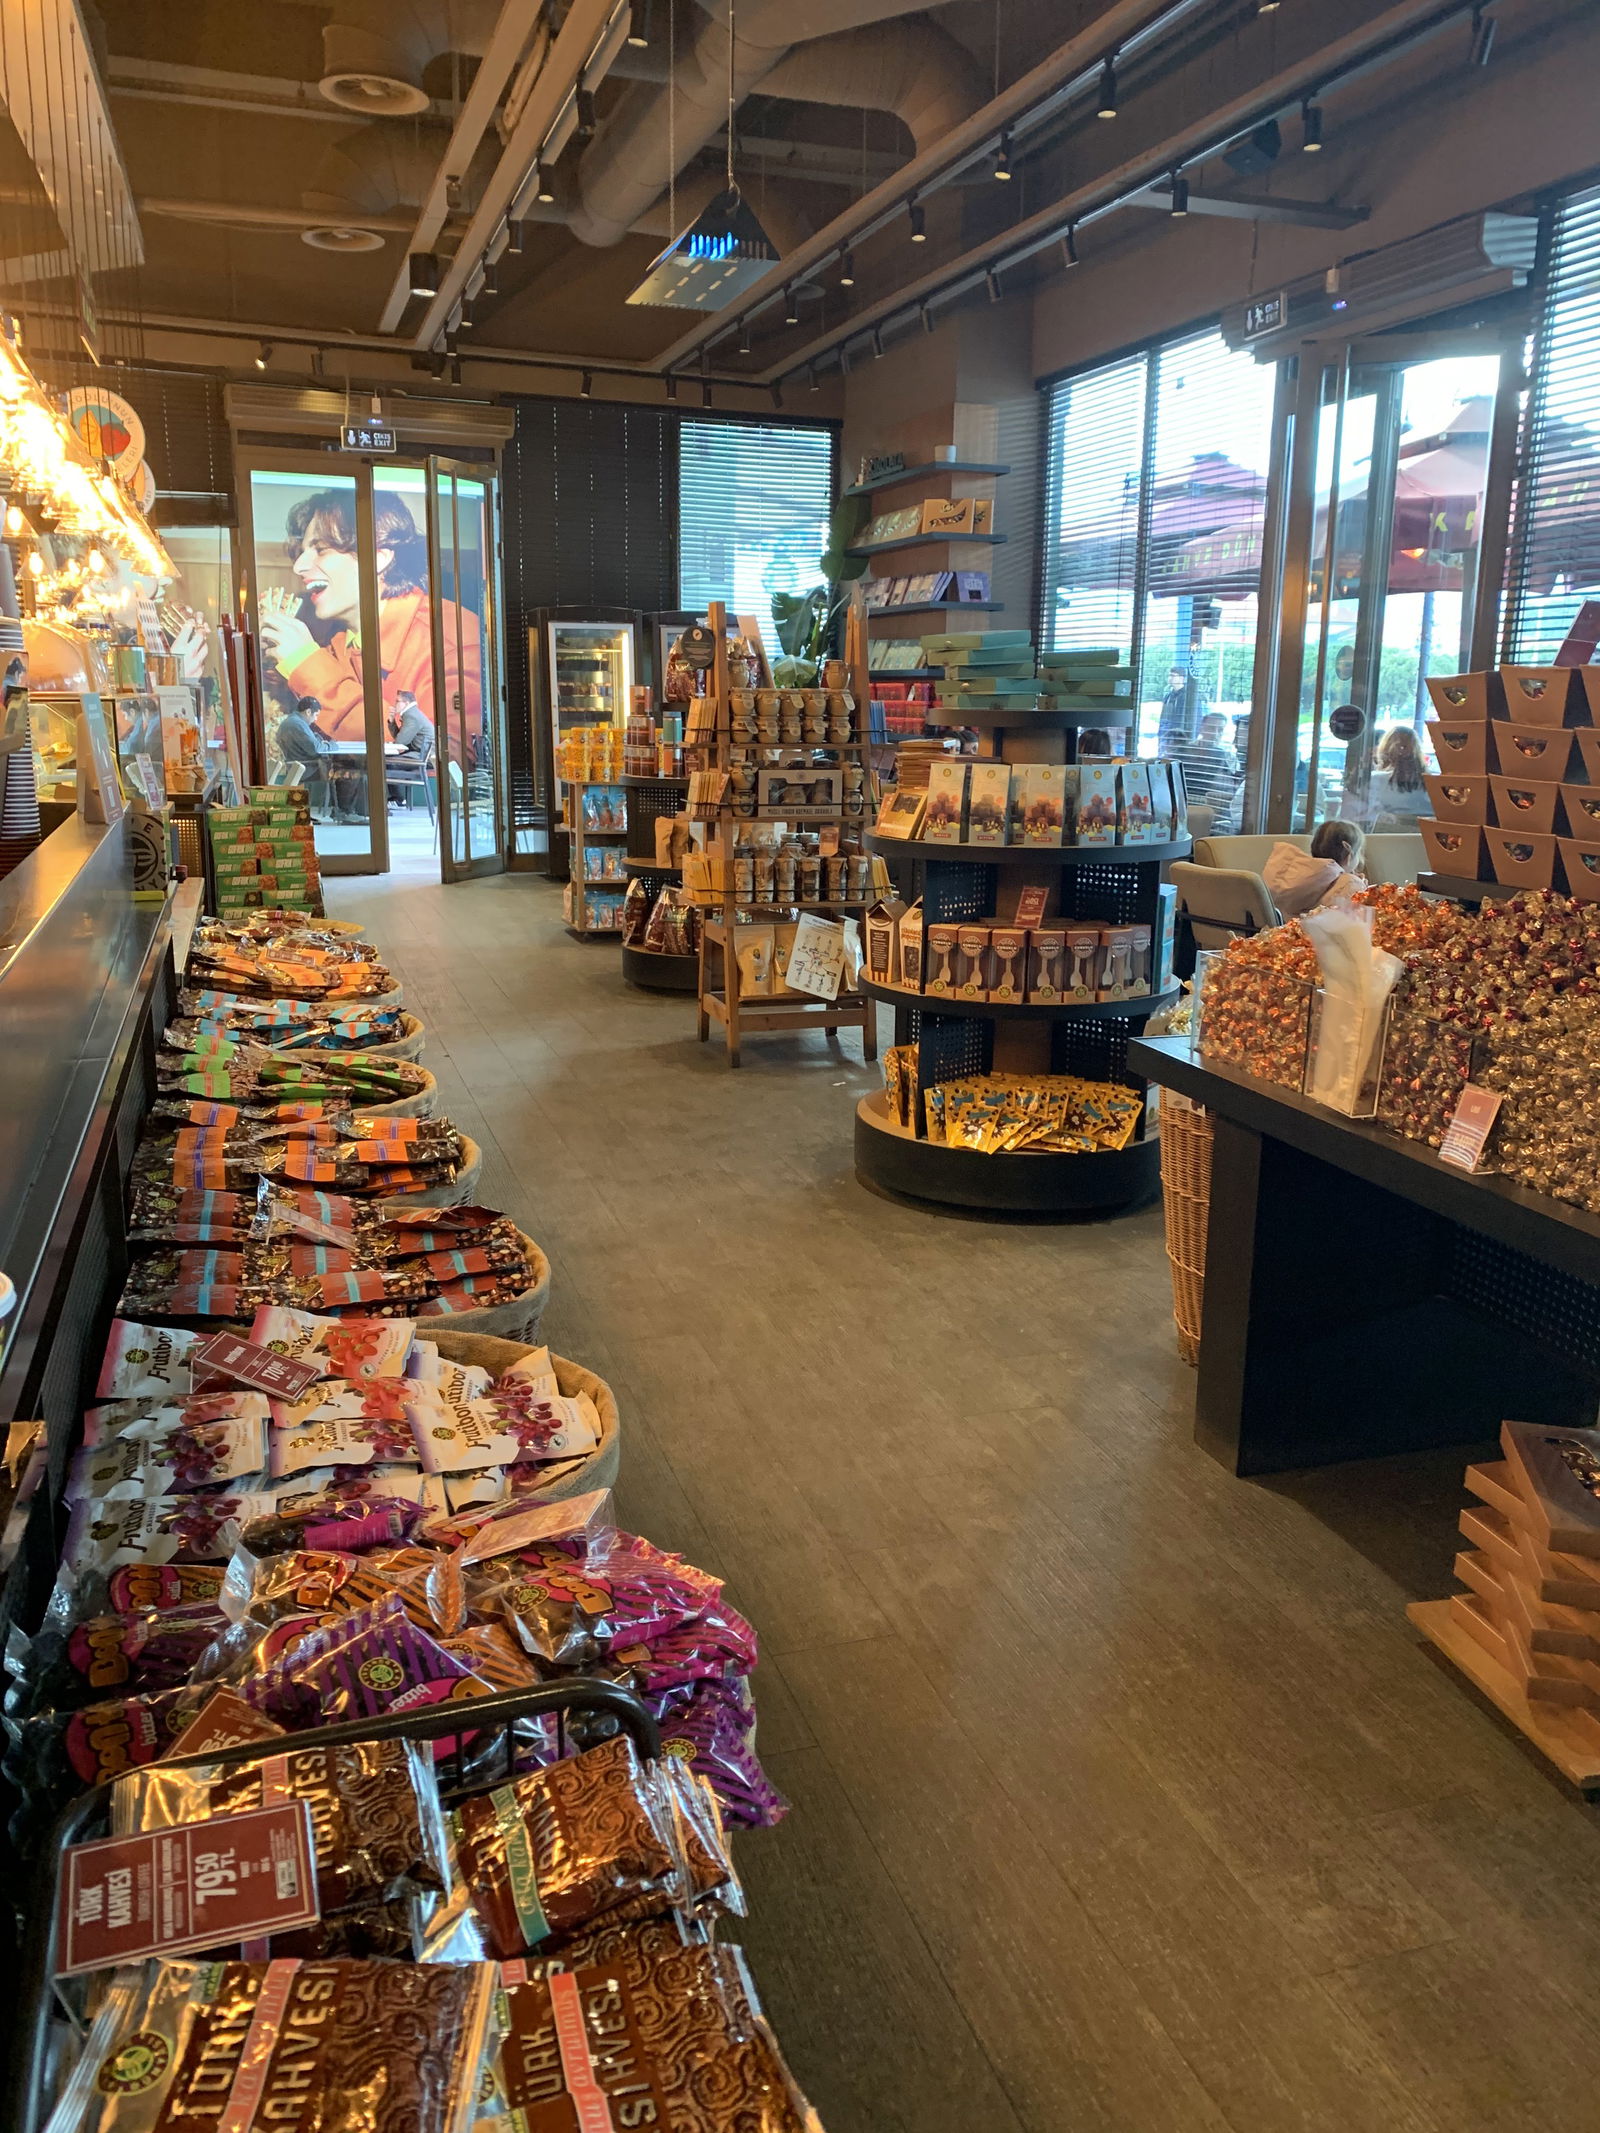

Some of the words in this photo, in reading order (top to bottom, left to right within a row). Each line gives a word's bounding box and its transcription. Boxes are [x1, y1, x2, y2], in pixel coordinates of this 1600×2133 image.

[457, 1400, 492, 1450] Frutibon
[389, 1683, 432, 1713] bitter
[140, 1711, 158, 1747] bitter
[220, 1847, 235, 1868] TL
[76, 1884, 103, 1927] TÜRK
[105, 1867, 132, 1929] KAHVESİ
